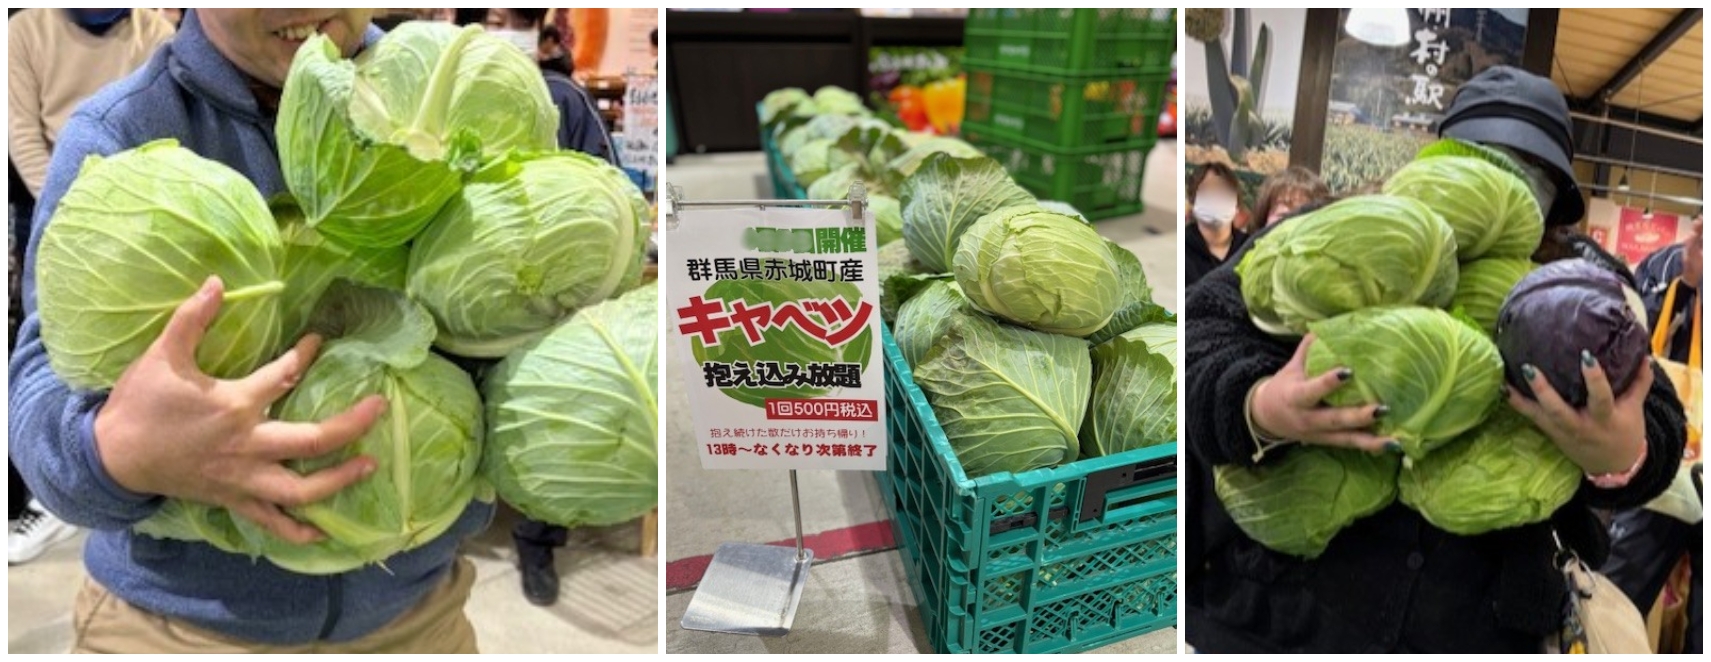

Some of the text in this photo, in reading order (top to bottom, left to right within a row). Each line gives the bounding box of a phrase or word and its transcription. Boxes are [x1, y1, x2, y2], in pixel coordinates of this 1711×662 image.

[686, 257, 864, 282] 群馬県赤城町産
[677, 295, 874, 346] キャベツ
[703, 361, 862, 388] 抱え込み放題
[767, 401, 874, 418] 1回500円税込
